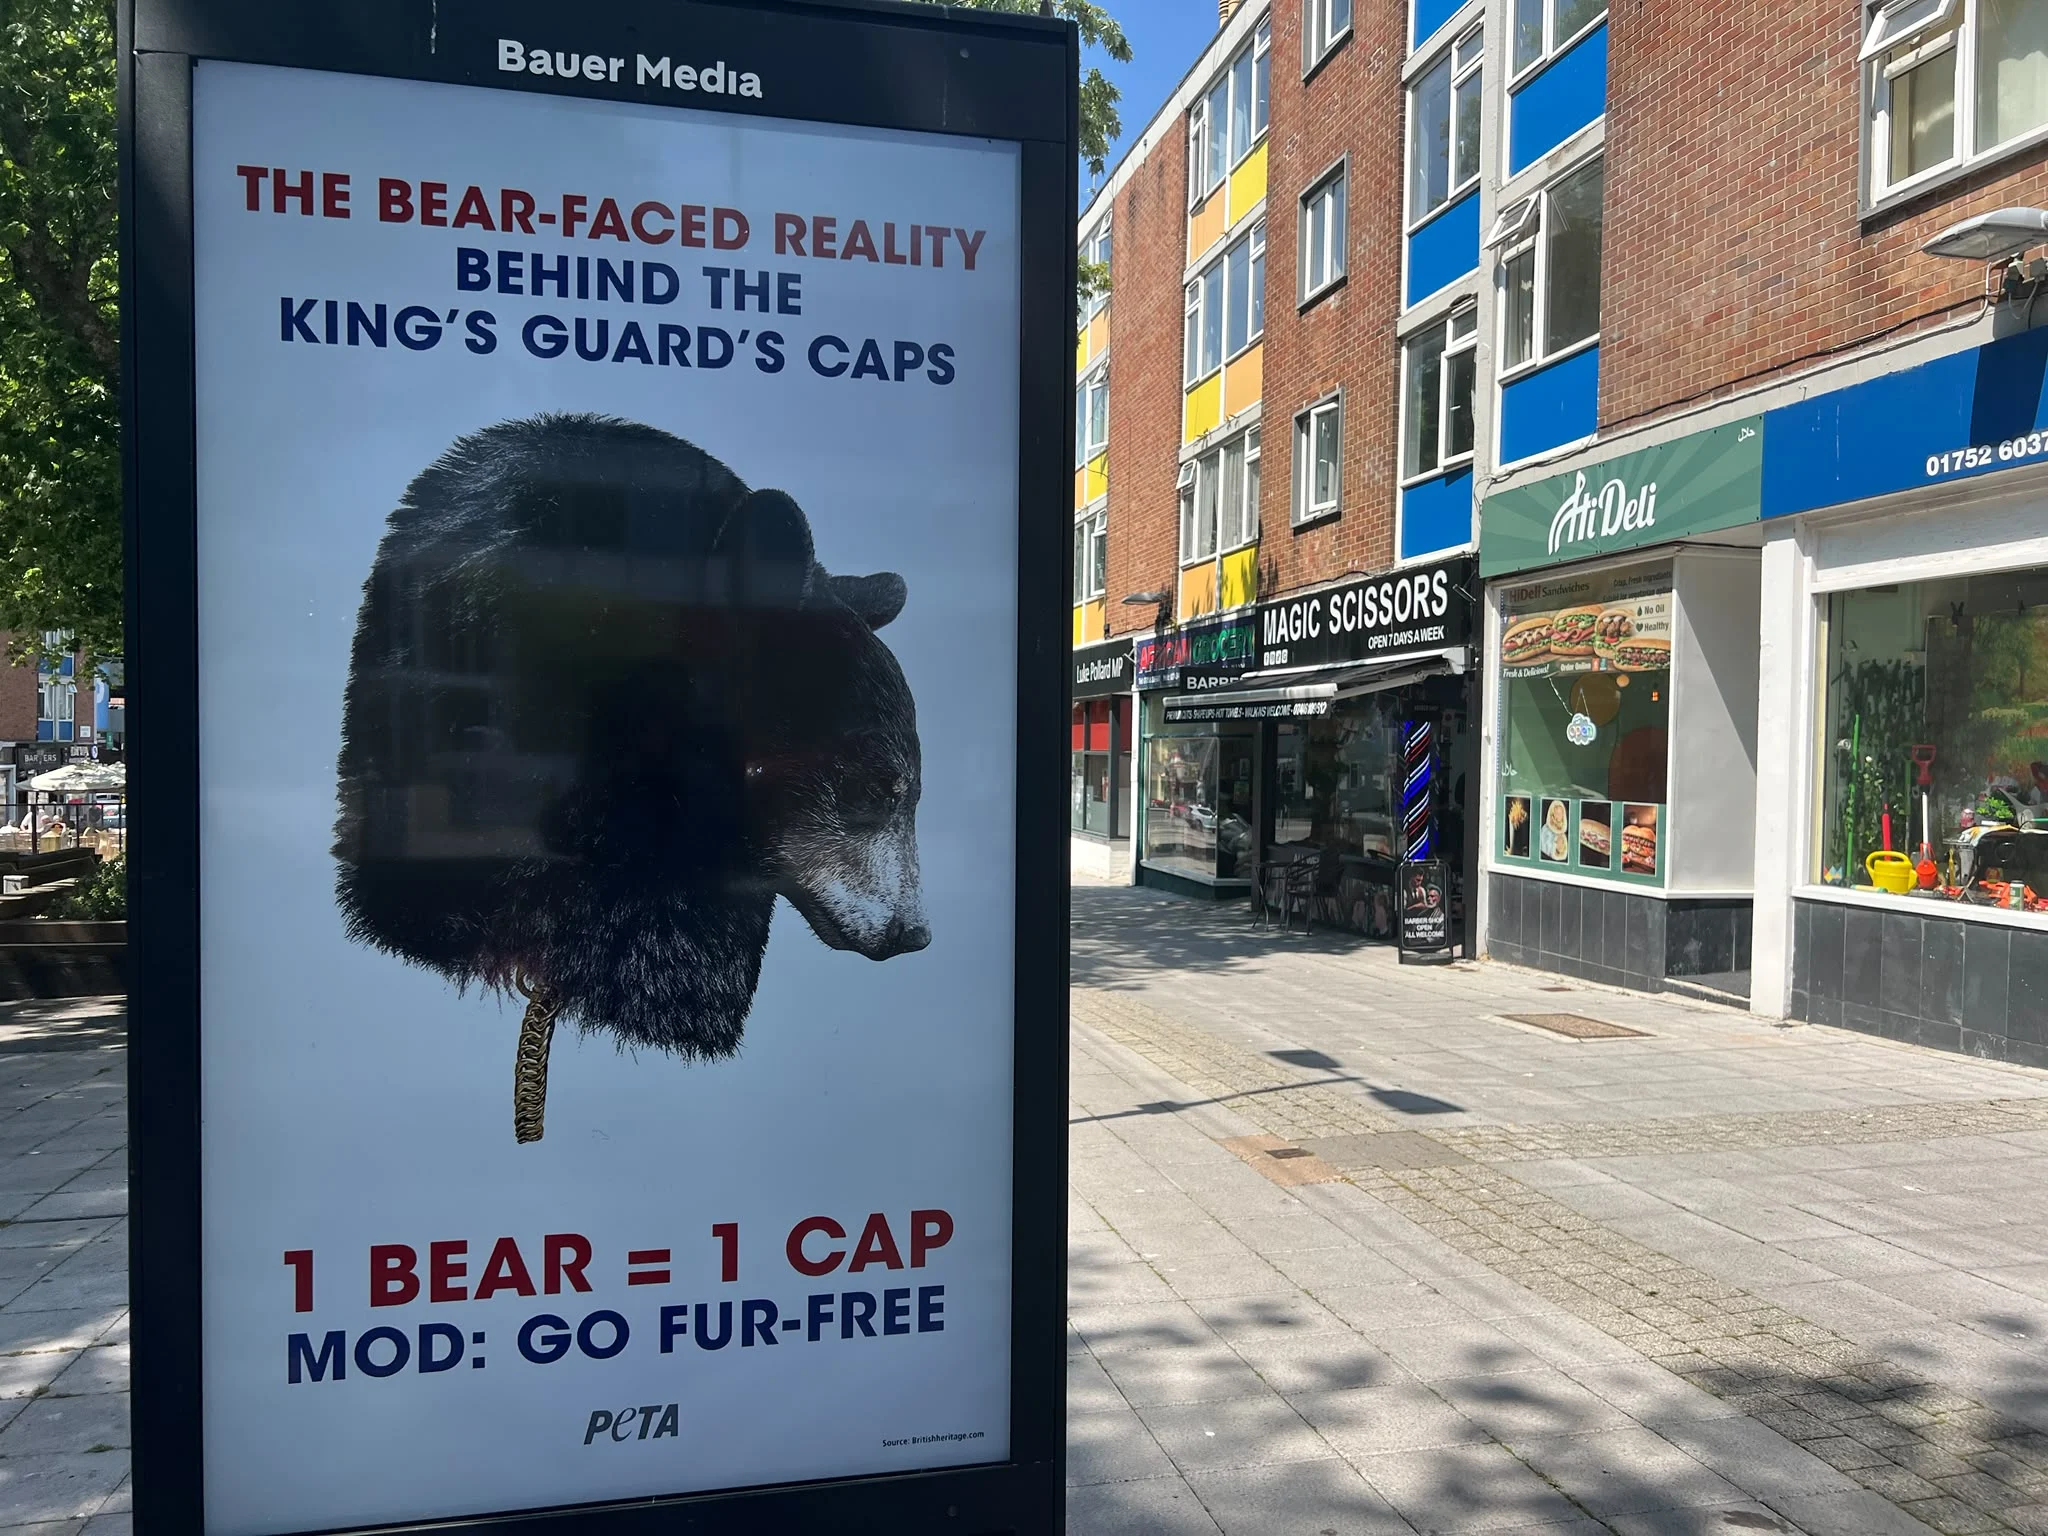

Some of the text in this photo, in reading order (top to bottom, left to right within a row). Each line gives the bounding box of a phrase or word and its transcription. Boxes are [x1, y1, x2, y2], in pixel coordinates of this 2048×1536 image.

[497, 38, 763, 98] Bauer Media
[236, 165, 987, 271] THE BEAR-FACED REALITY
[456, 247, 802, 316] BEHIND THE
[280, 297, 956, 387] KING’S GUARD’S CAPS
[1925, 444, 1992, 477] 01752
[1548, 470, 1657, 556] Hi Deli
[1542, 581, 1590, 598] Sandwiches
[1263, 569, 1448, 646] MAGIC SCISSORS
[1644, 603, 1665, 615] No Oil
[1368, 625, 1445, 650] OPEN 7 DAYS A WEEK
[1644, 621, 1670, 632] Healthy
[1076, 656, 1124, 684] Luke Pollard MP
[1502, 668, 1518, 678] Fresh
[1523, 663, 1550, 677] Delicious!
[1560, 662, 1575, 672] Order
[1187, 676, 1243, 690] BARB
[284, 1249, 313, 1313] 1
[369, 1232, 593, 1308] BEAR
[712, 1222, 739, 1282] 1
[786, 1208, 954, 1278] CAP
[288, 1285, 946, 1385] MOD: GO FUR-FREE
[881, 1429, 985, 1448] Source: Britishheritage.com
